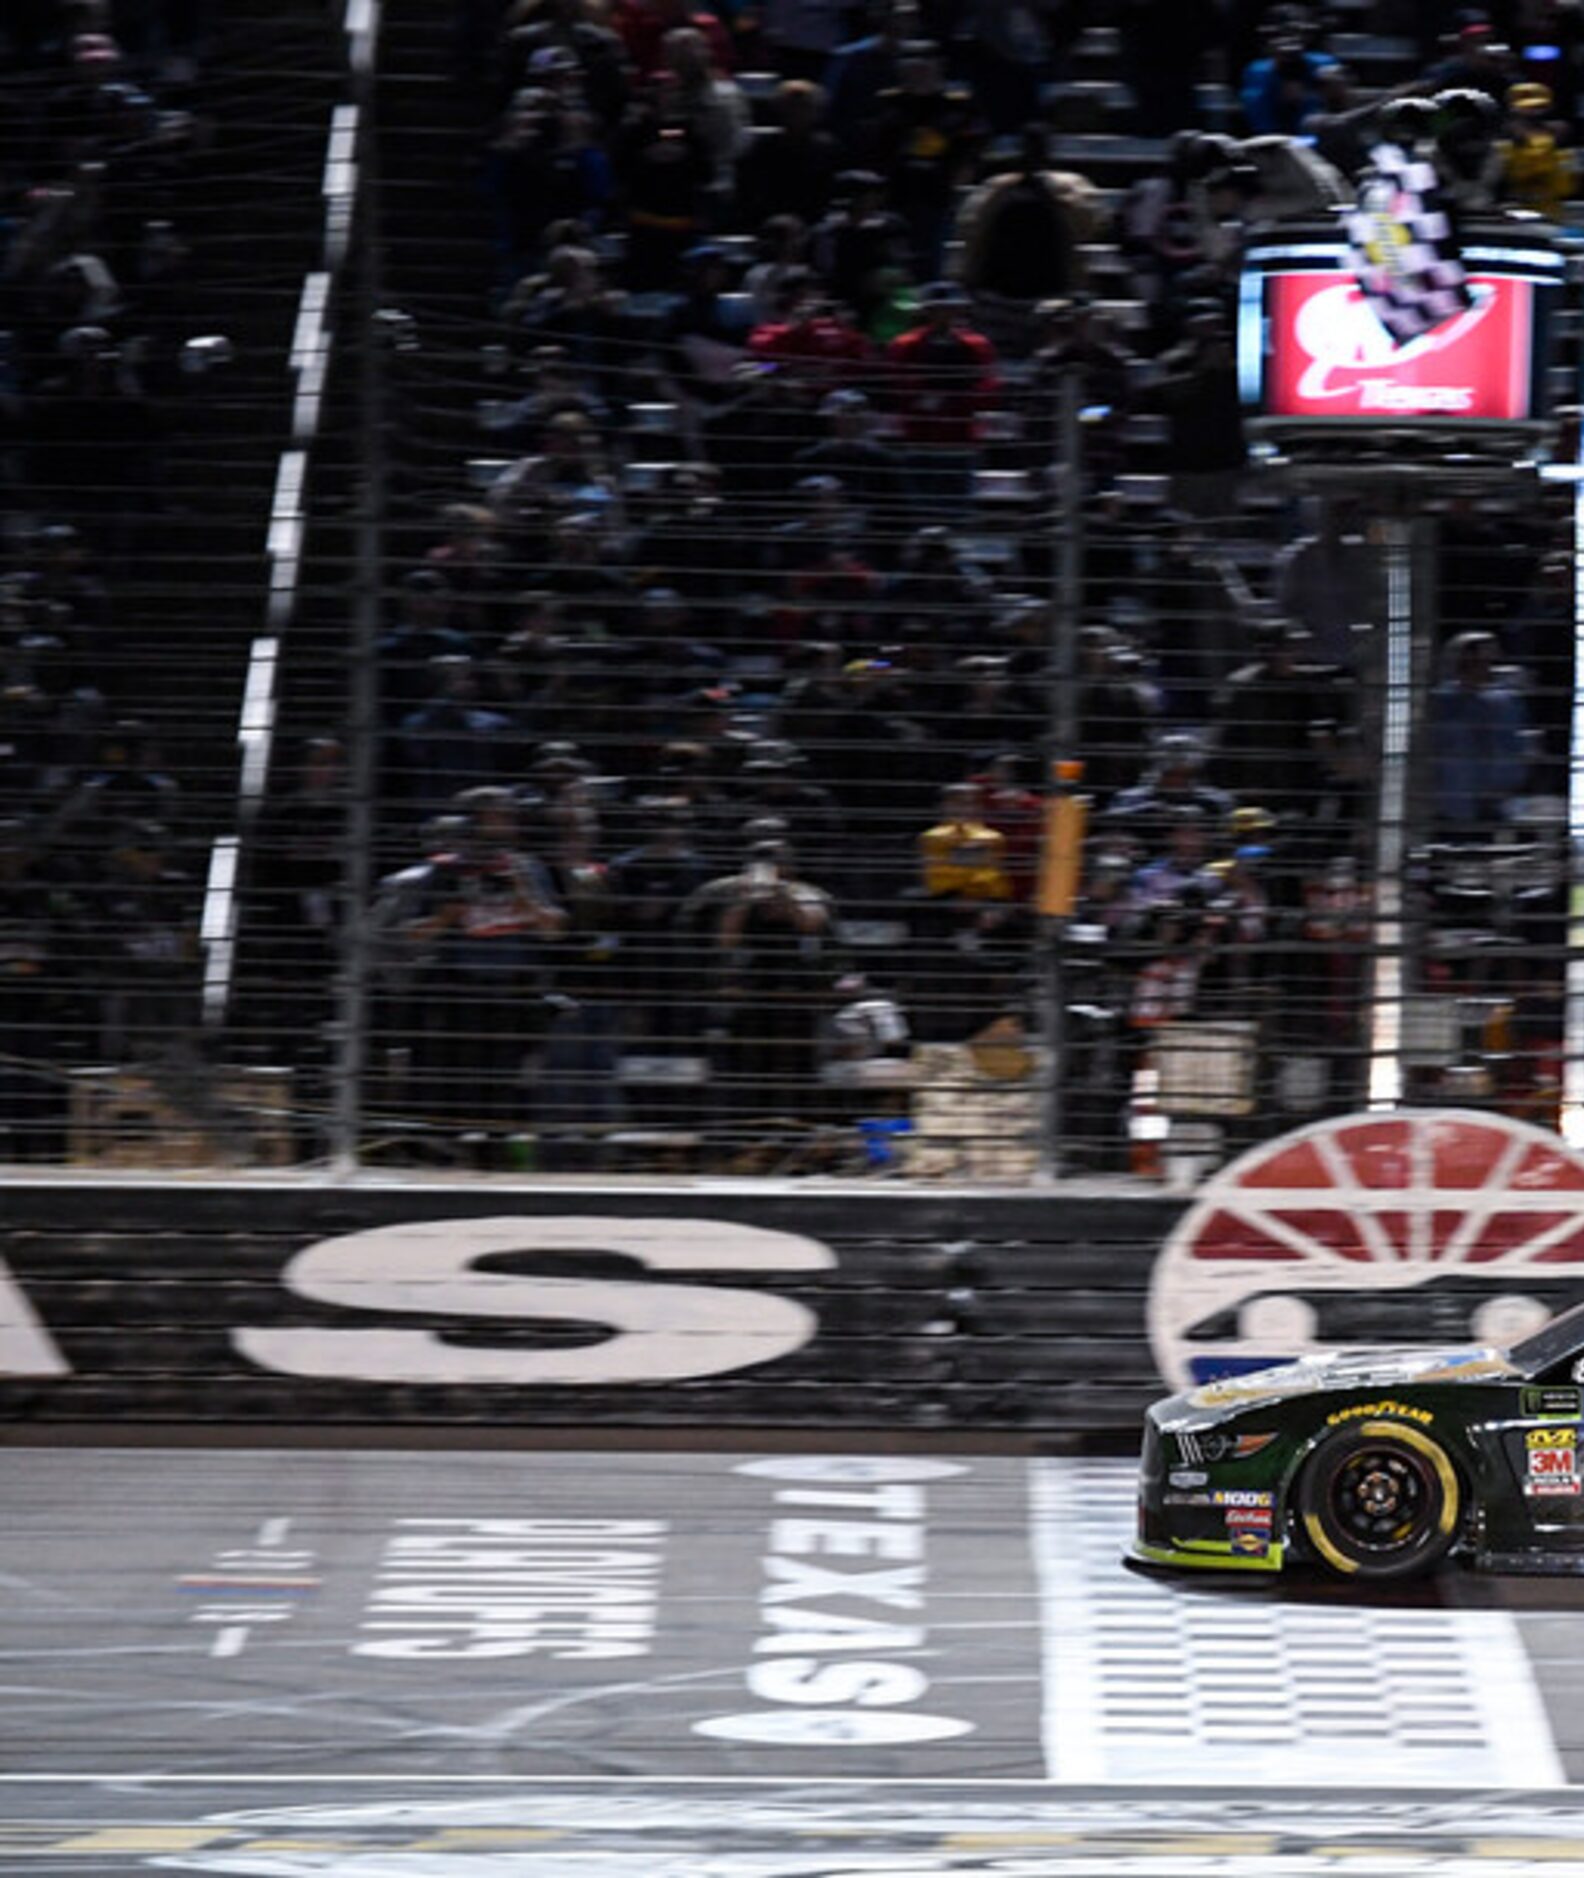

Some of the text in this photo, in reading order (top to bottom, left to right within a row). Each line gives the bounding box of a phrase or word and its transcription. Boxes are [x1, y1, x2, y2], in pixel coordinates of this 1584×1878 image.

[1326, 1400, 1435, 1426] GOODYEAR
[1531, 1449, 1573, 1474] 3M
[350, 1518, 668, 1660] PLAYOFFS
[747, 1485, 928, 1706] TEXAS
